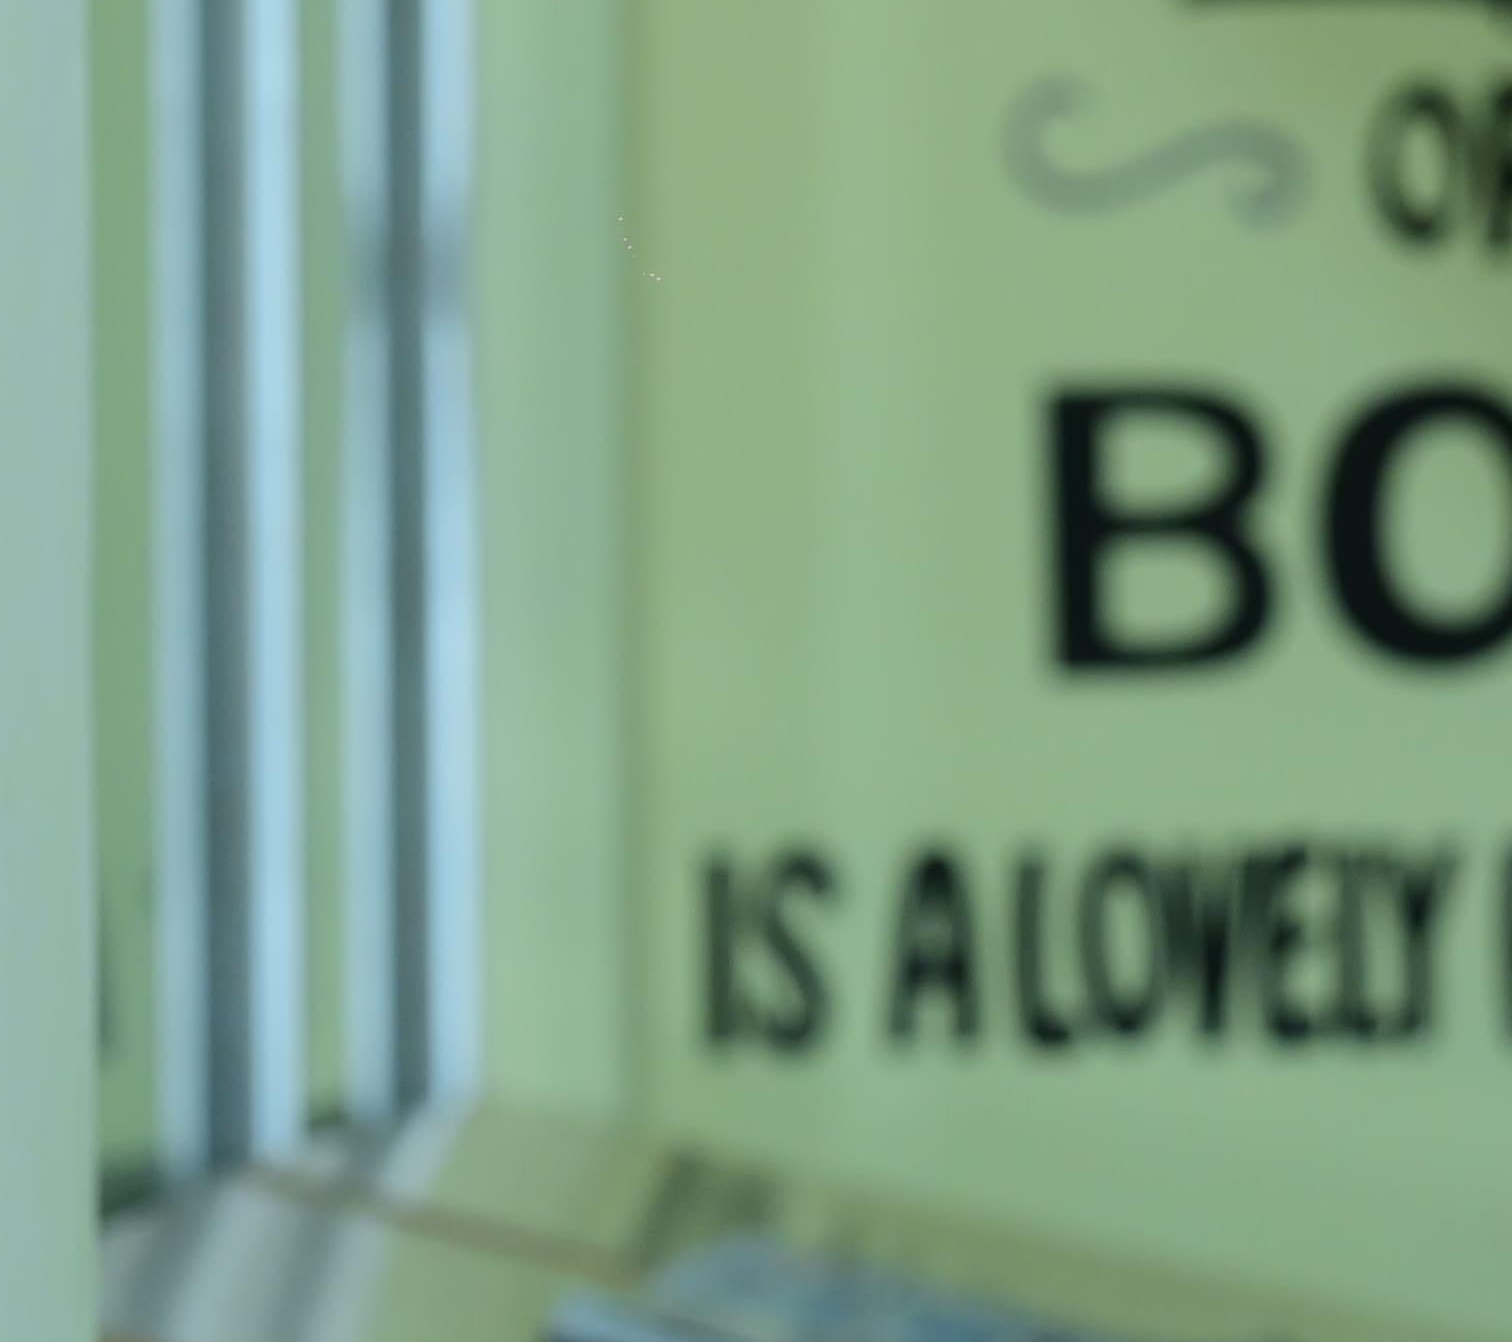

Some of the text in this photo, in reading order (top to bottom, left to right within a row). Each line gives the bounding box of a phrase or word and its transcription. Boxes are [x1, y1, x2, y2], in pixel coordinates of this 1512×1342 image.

[700, 839, 836, 1055] IS
[888, 841, 982, 1051] A
[1010, 837, 1456, 1051] LOVELY
